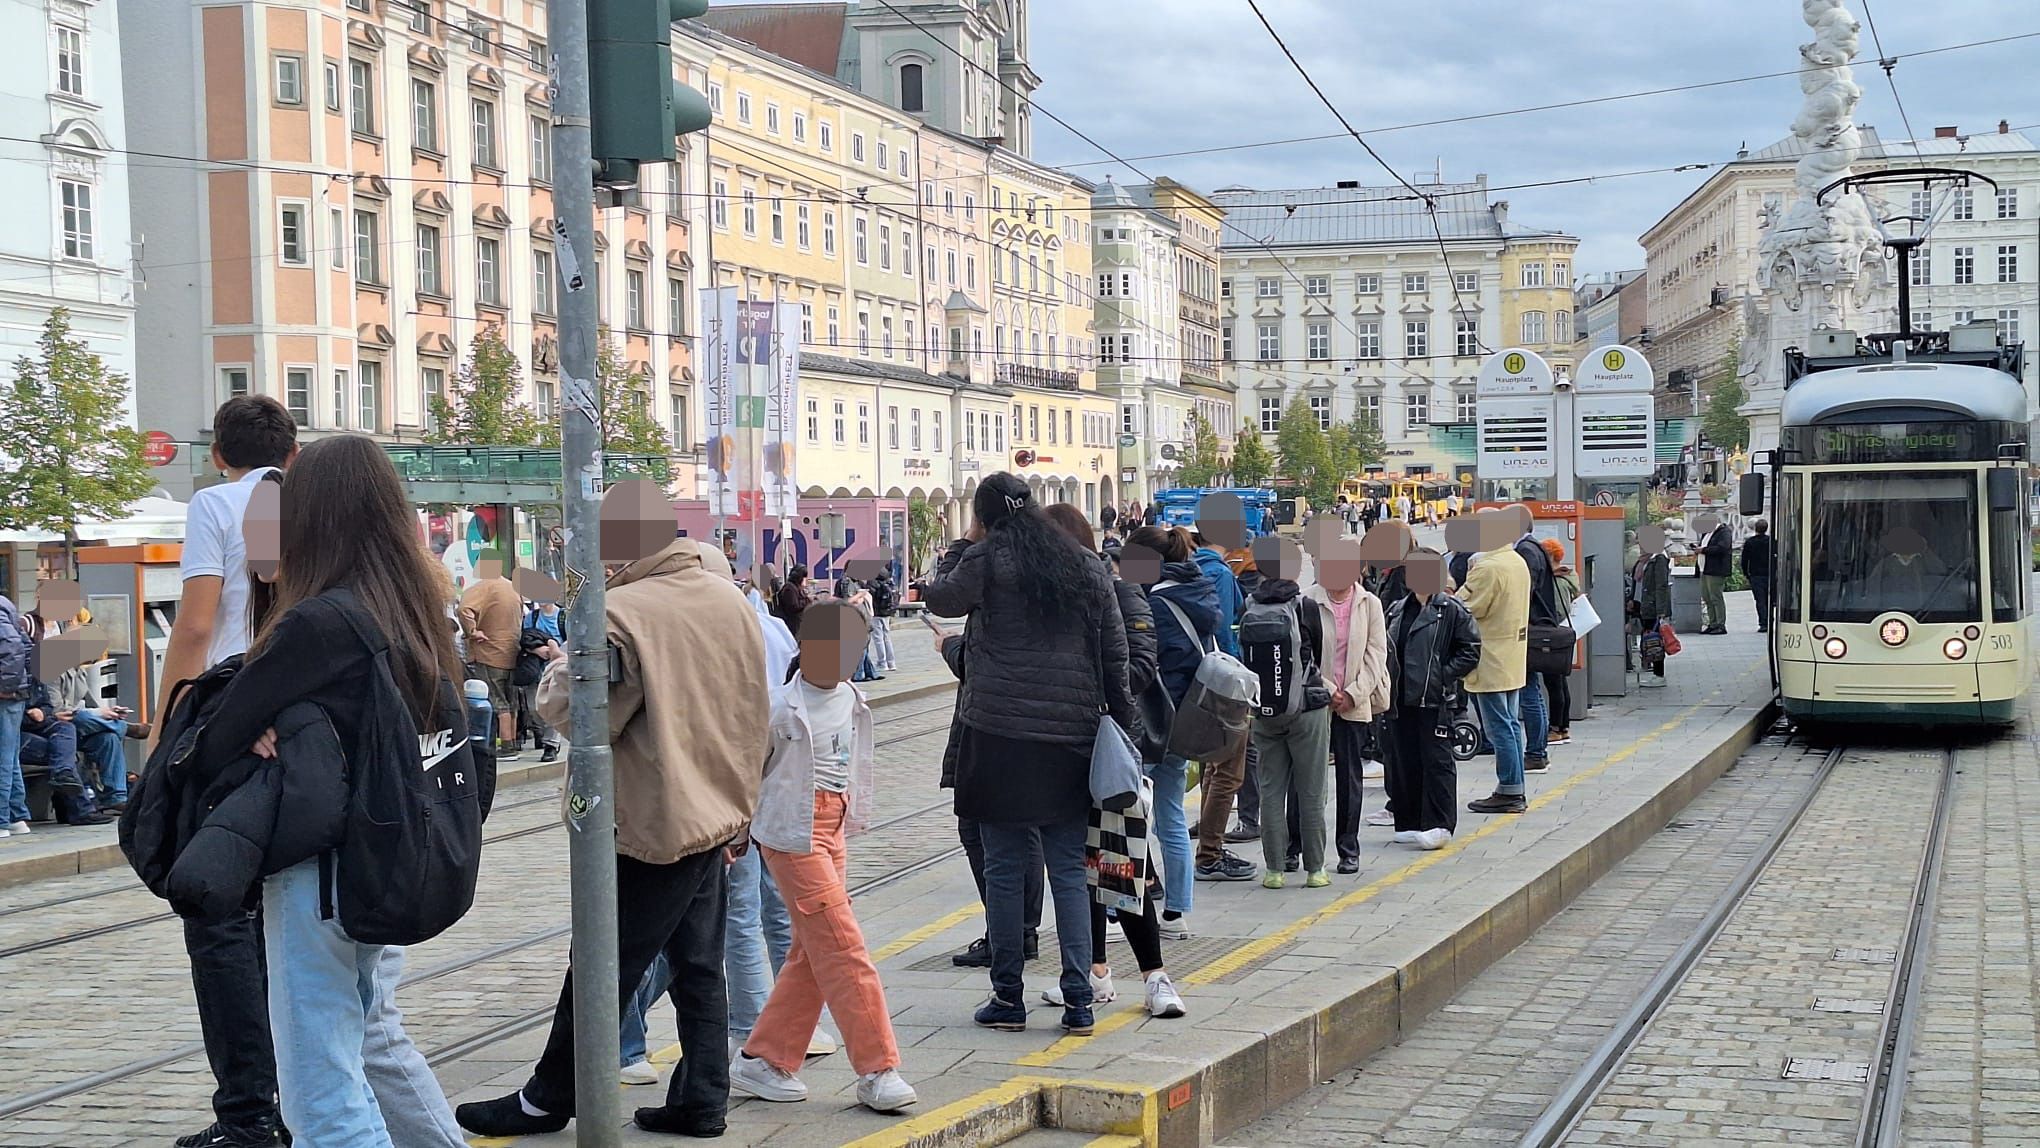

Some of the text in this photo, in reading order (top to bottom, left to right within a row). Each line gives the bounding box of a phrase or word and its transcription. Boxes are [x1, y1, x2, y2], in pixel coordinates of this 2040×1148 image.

[1495, 376, 1534, 384] Hauptplatz
[1594, 373, 1634, 381] Hauptplatz
[1783, 633, 1802, 649] 503
[1991, 633, 2013, 650] 503
[1273, 644, 1283, 697] ORTOVOX
